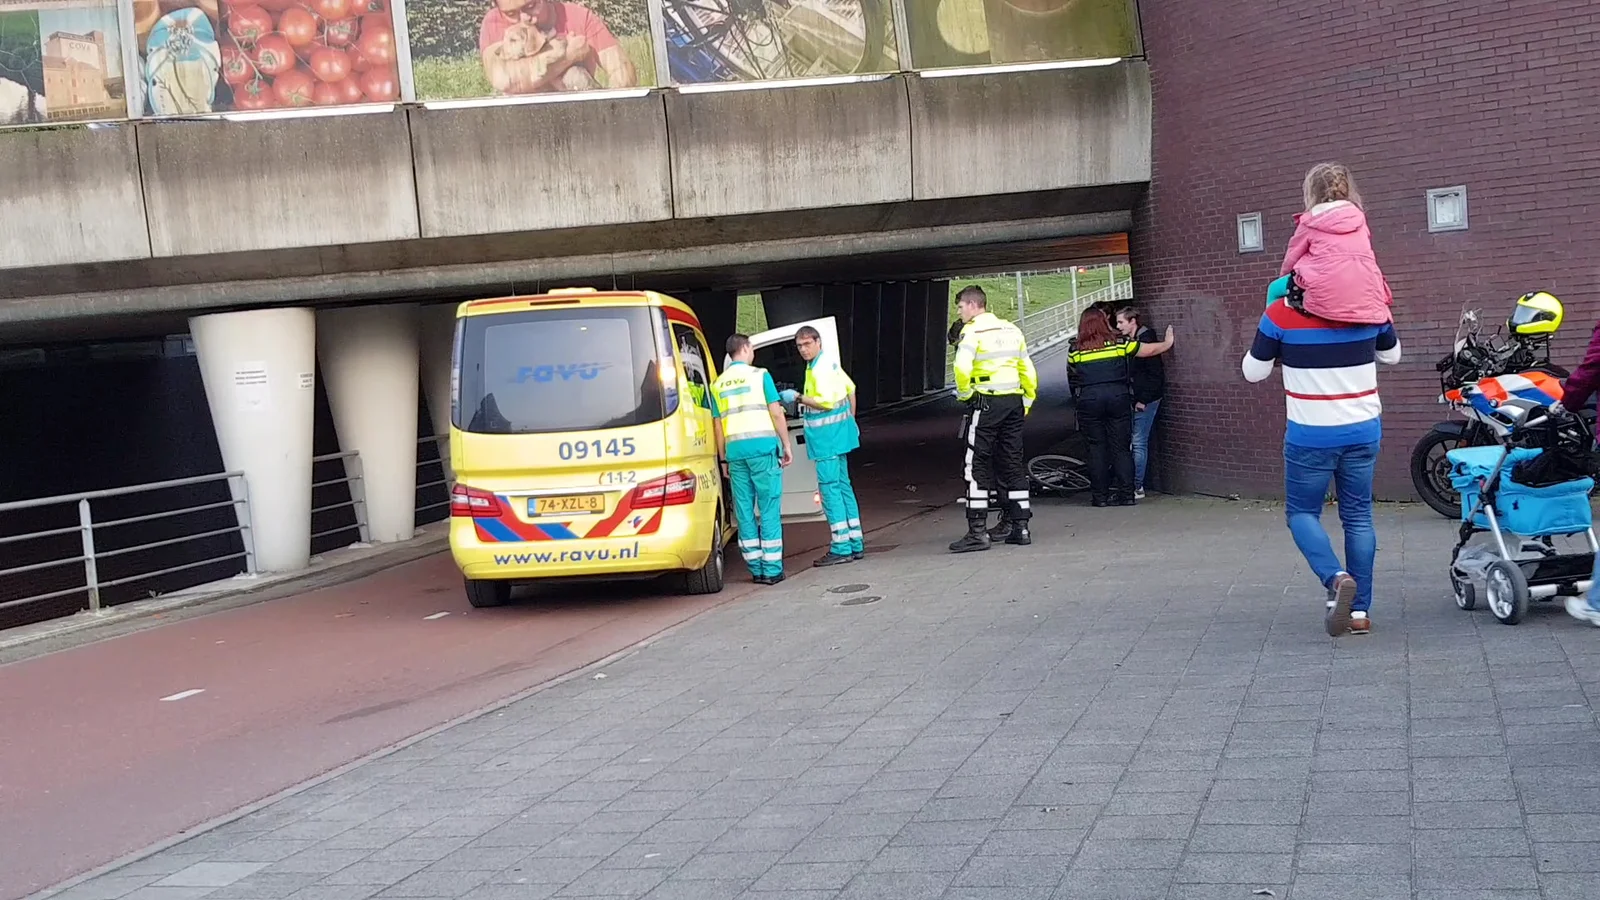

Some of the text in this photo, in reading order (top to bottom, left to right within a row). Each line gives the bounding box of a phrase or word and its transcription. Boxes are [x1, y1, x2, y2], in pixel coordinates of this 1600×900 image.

[558, 437, 636, 460] 09145
[540, 497, 597, 511] 74-XZL-8
[494, 541, 639, 565] www.ravu.nl
